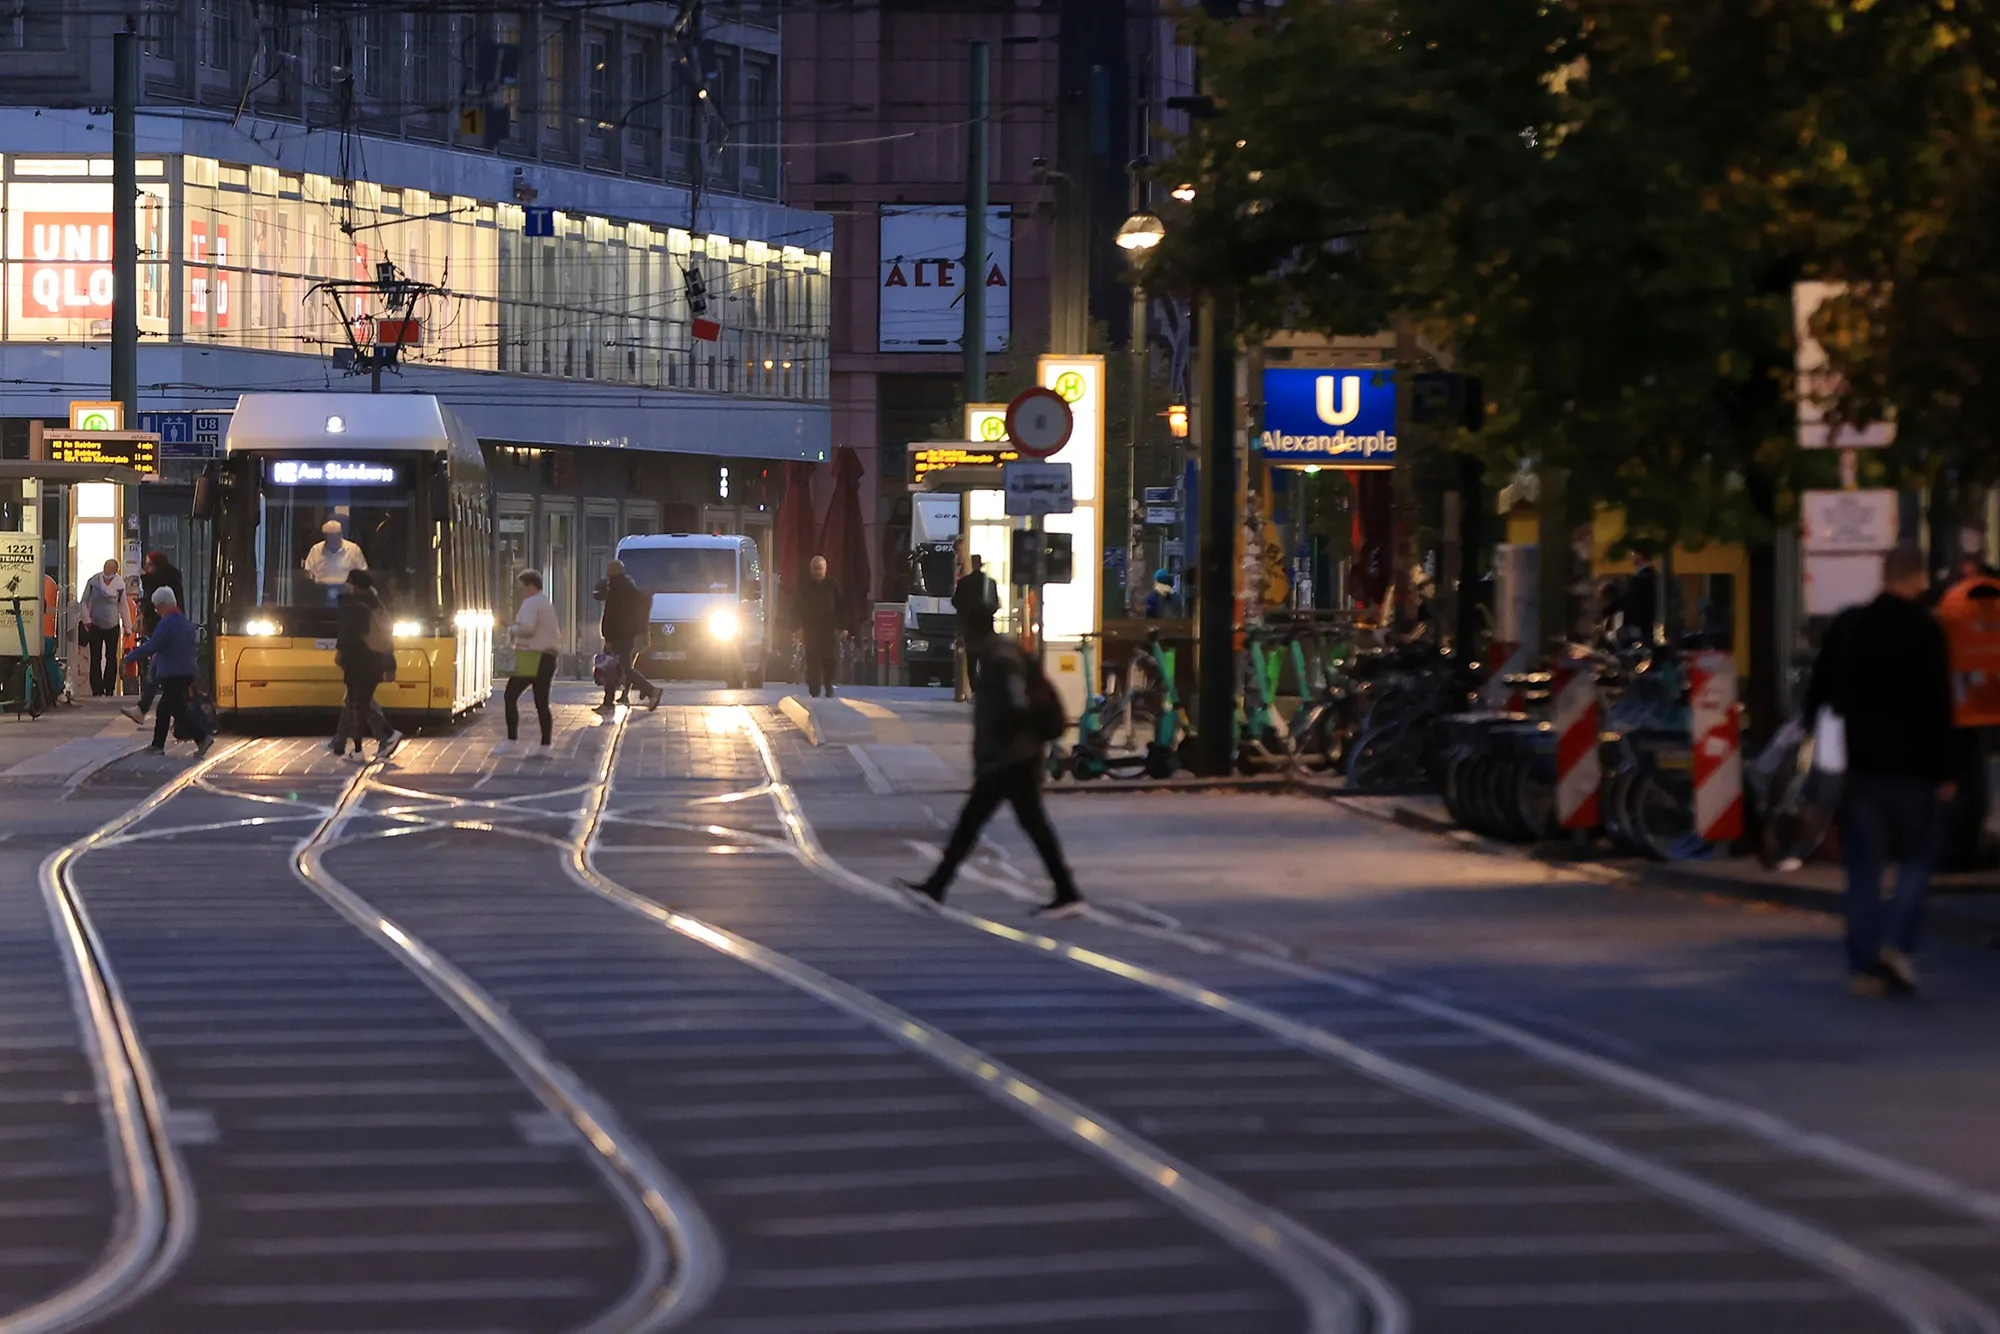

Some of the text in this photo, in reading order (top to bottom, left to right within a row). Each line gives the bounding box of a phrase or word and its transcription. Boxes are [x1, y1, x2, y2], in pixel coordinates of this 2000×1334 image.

[33, 224, 110, 261] UNI
[32, 268, 113, 313] QLO
[1064, 377, 1079, 395] H
[1315, 375, 1360, 426] U
[199, 418, 217, 430] U8
[987, 422, 999, 436] H
[7, 545, 33, 554] 1221
